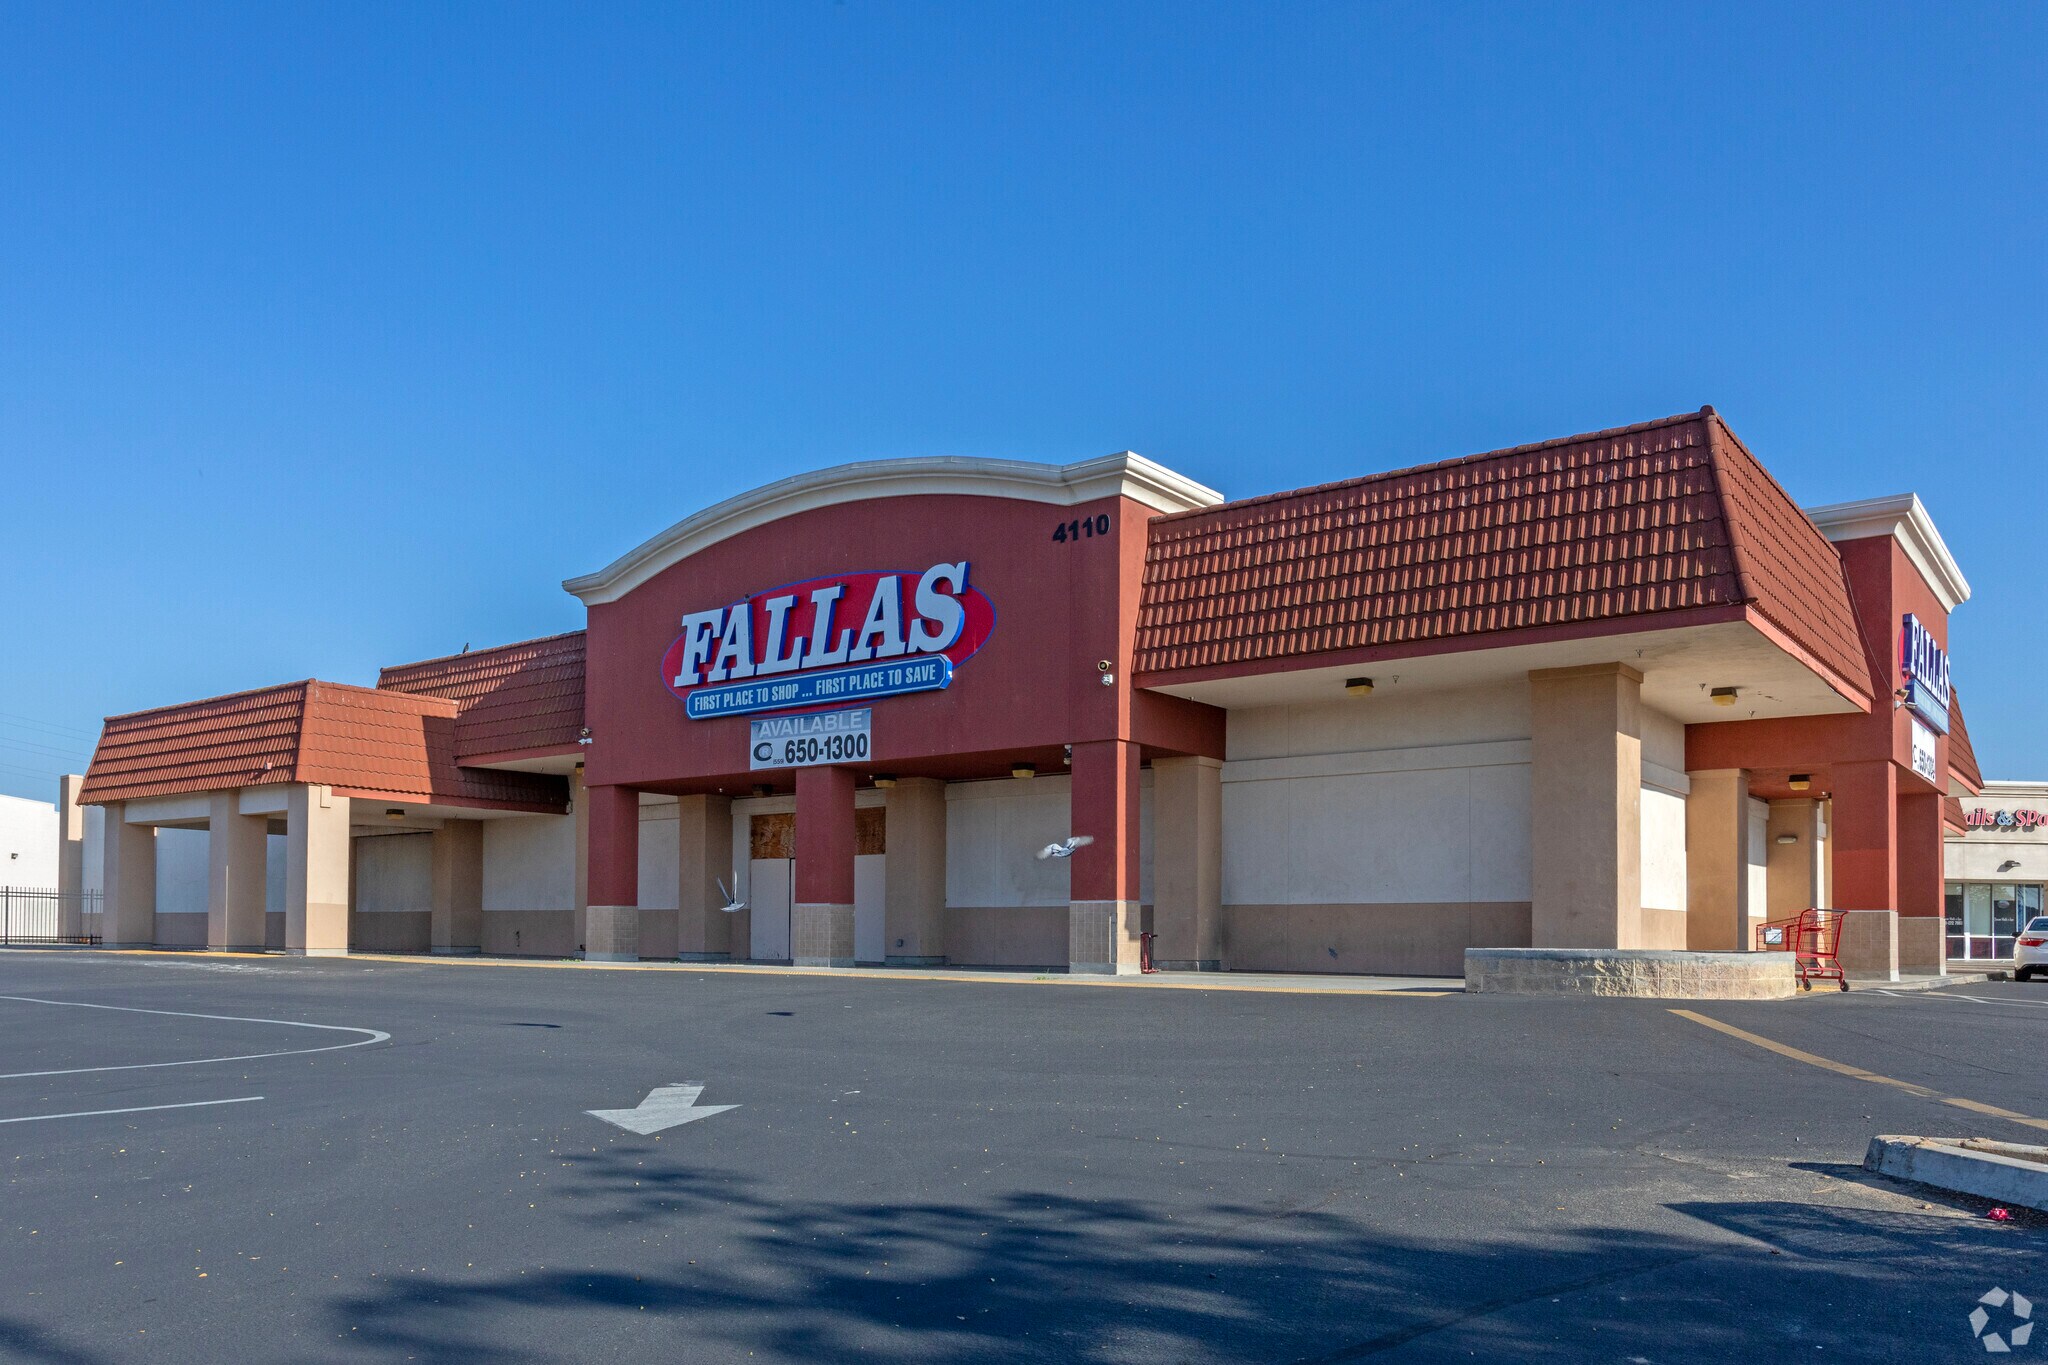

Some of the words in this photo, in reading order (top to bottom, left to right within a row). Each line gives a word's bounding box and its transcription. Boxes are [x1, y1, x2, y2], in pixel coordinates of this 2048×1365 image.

[1052, 514, 1111, 543] 4110
[674, 561, 970, 687] FALLAS
[1910, 612, 1950, 711] FALLAS
[694, 693, 721, 712] FIRST
[723, 689, 754, 708] PLACE
[756, 687, 769, 703] TO
[771, 683, 799, 702] SHOP
[816, 676, 846, 696] FIRST
[849, 671, 884, 691] PLACE
[887, 668, 902, 686] TO
[905, 664, 936, 684] SAVE
[759, 711, 863, 738] AVAILABLE
[785, 733, 868, 764] 650-1300
[1964, 808, 1994, 826] ails
[1997, 809, 2013, 826] &
